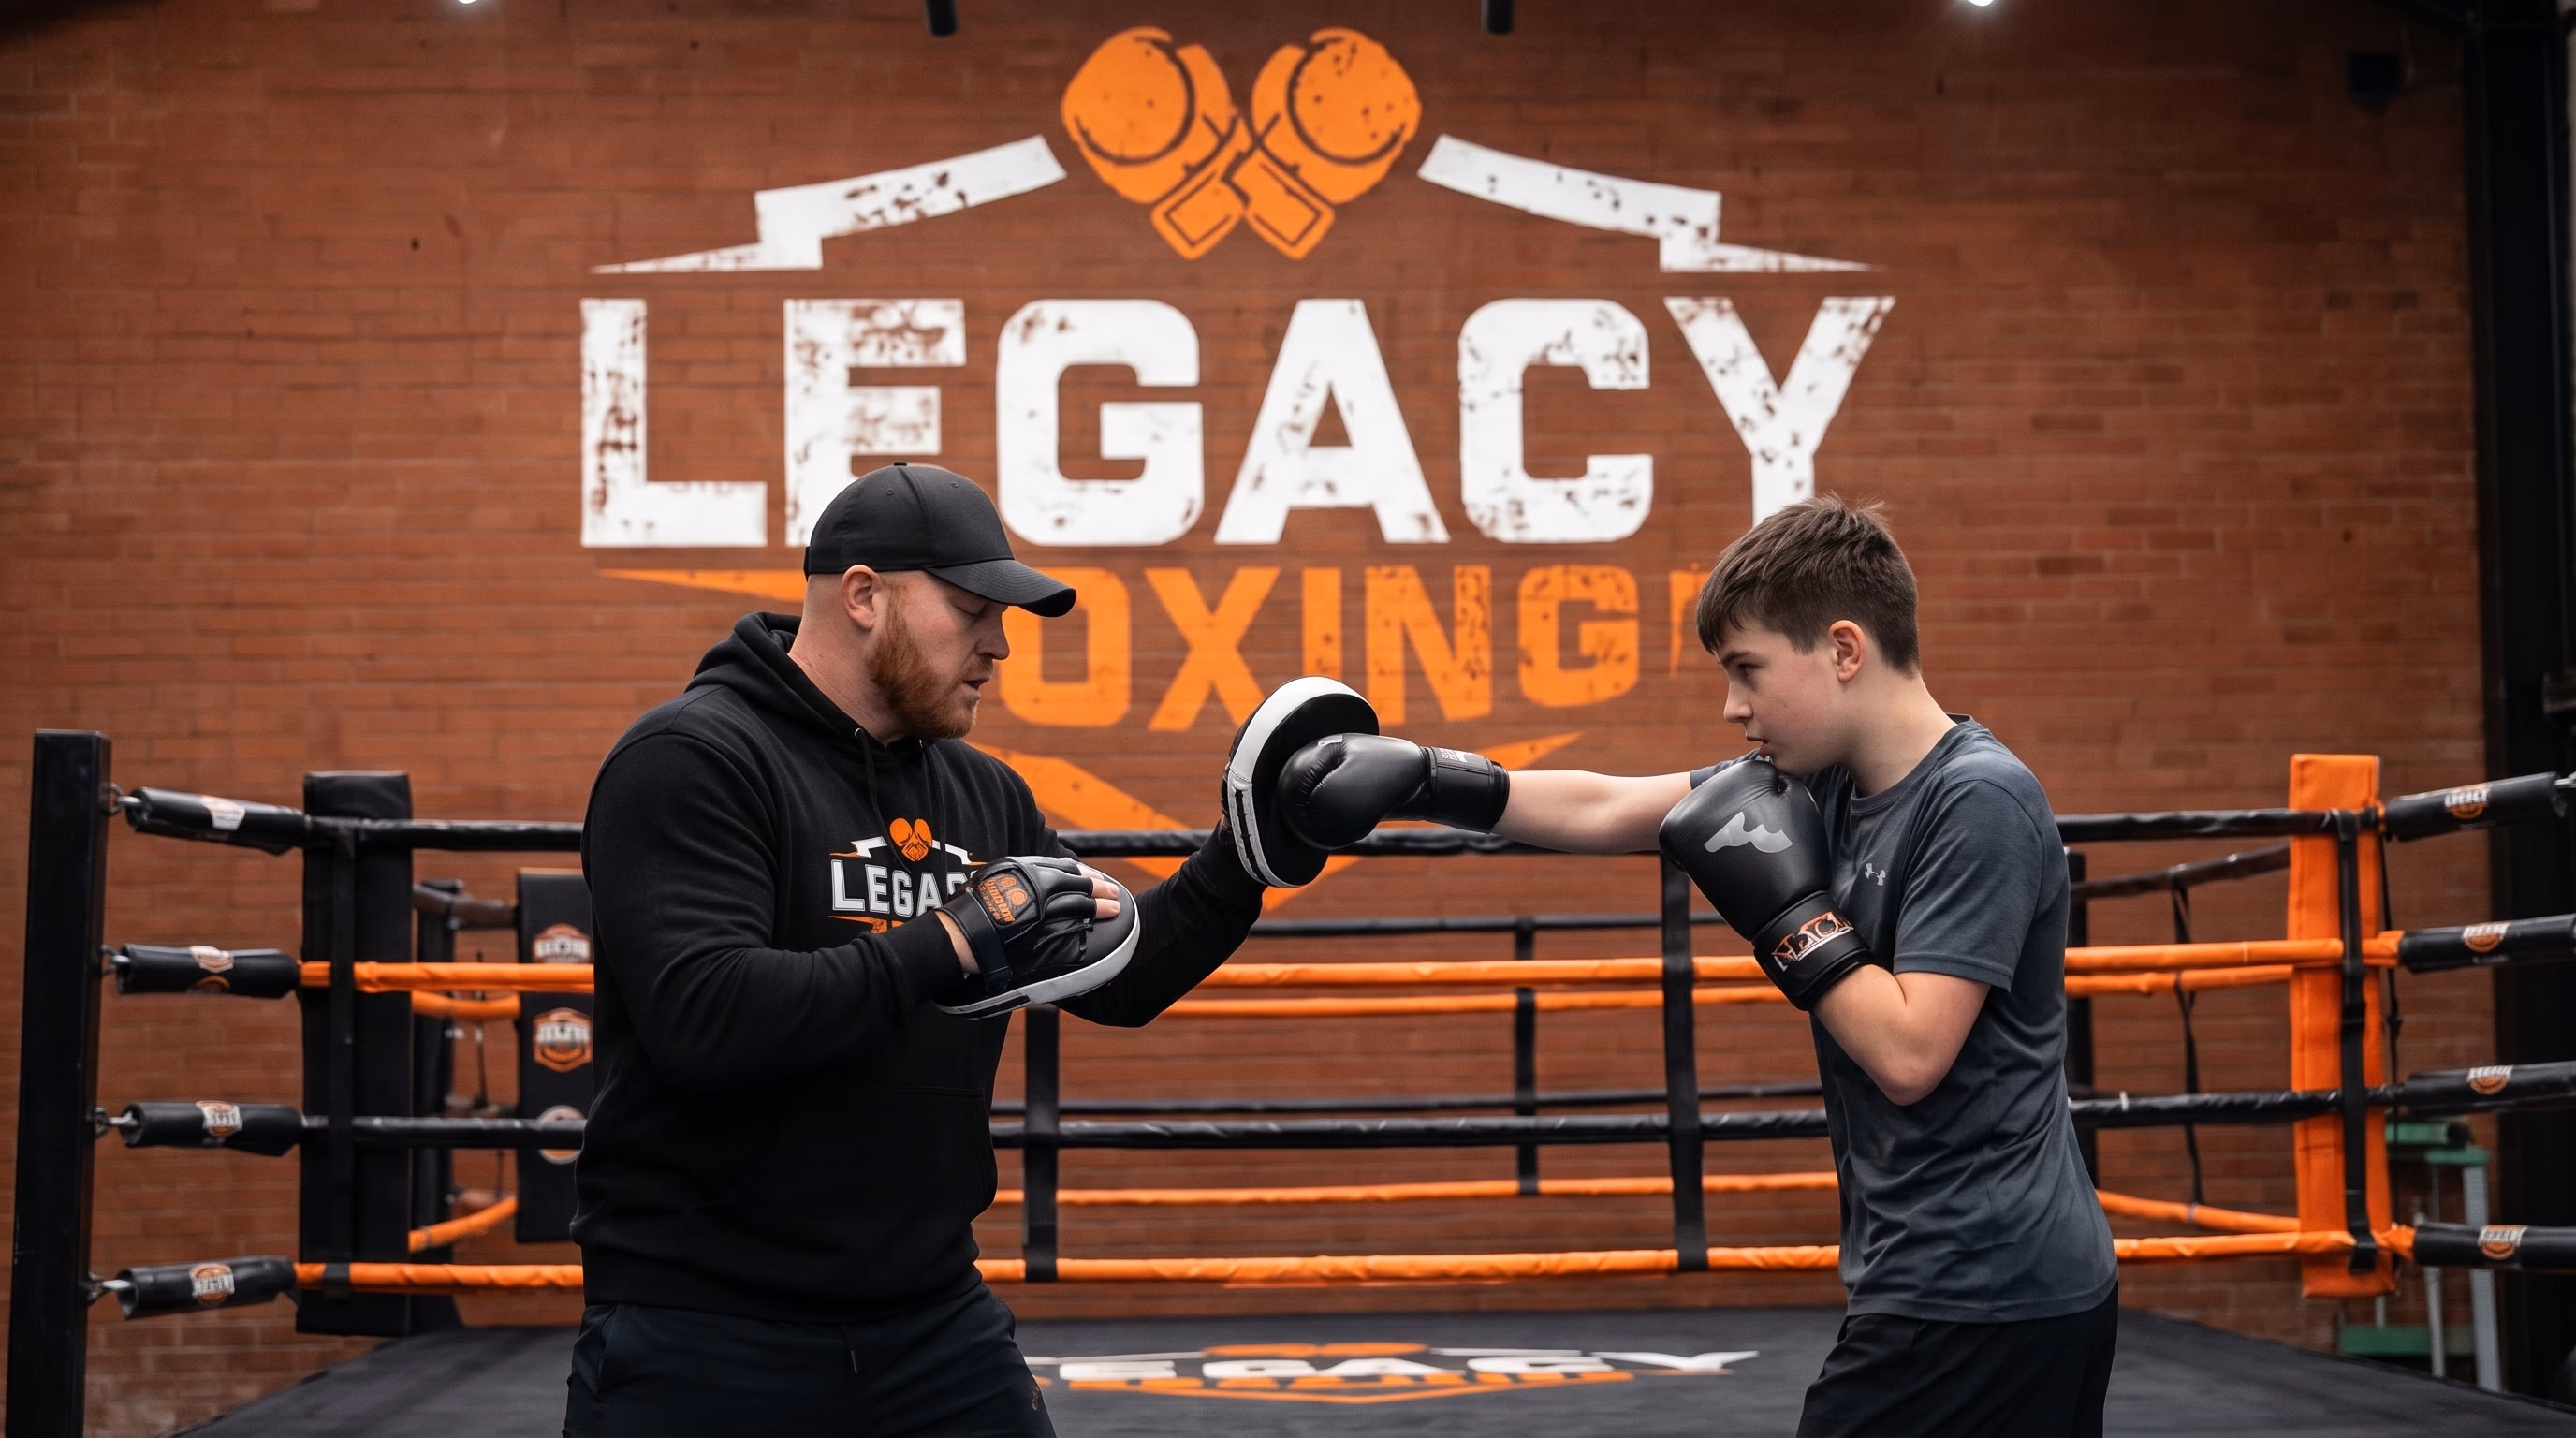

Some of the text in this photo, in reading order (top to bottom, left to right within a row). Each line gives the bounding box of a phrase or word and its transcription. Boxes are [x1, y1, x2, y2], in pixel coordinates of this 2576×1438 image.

[579, 296, 1896, 548] LEGACY
[999, 565, 1640, 732] OXING
[830, 858, 979, 917] LEGA
[1058, 1350, 1760, 1380] EGACY
